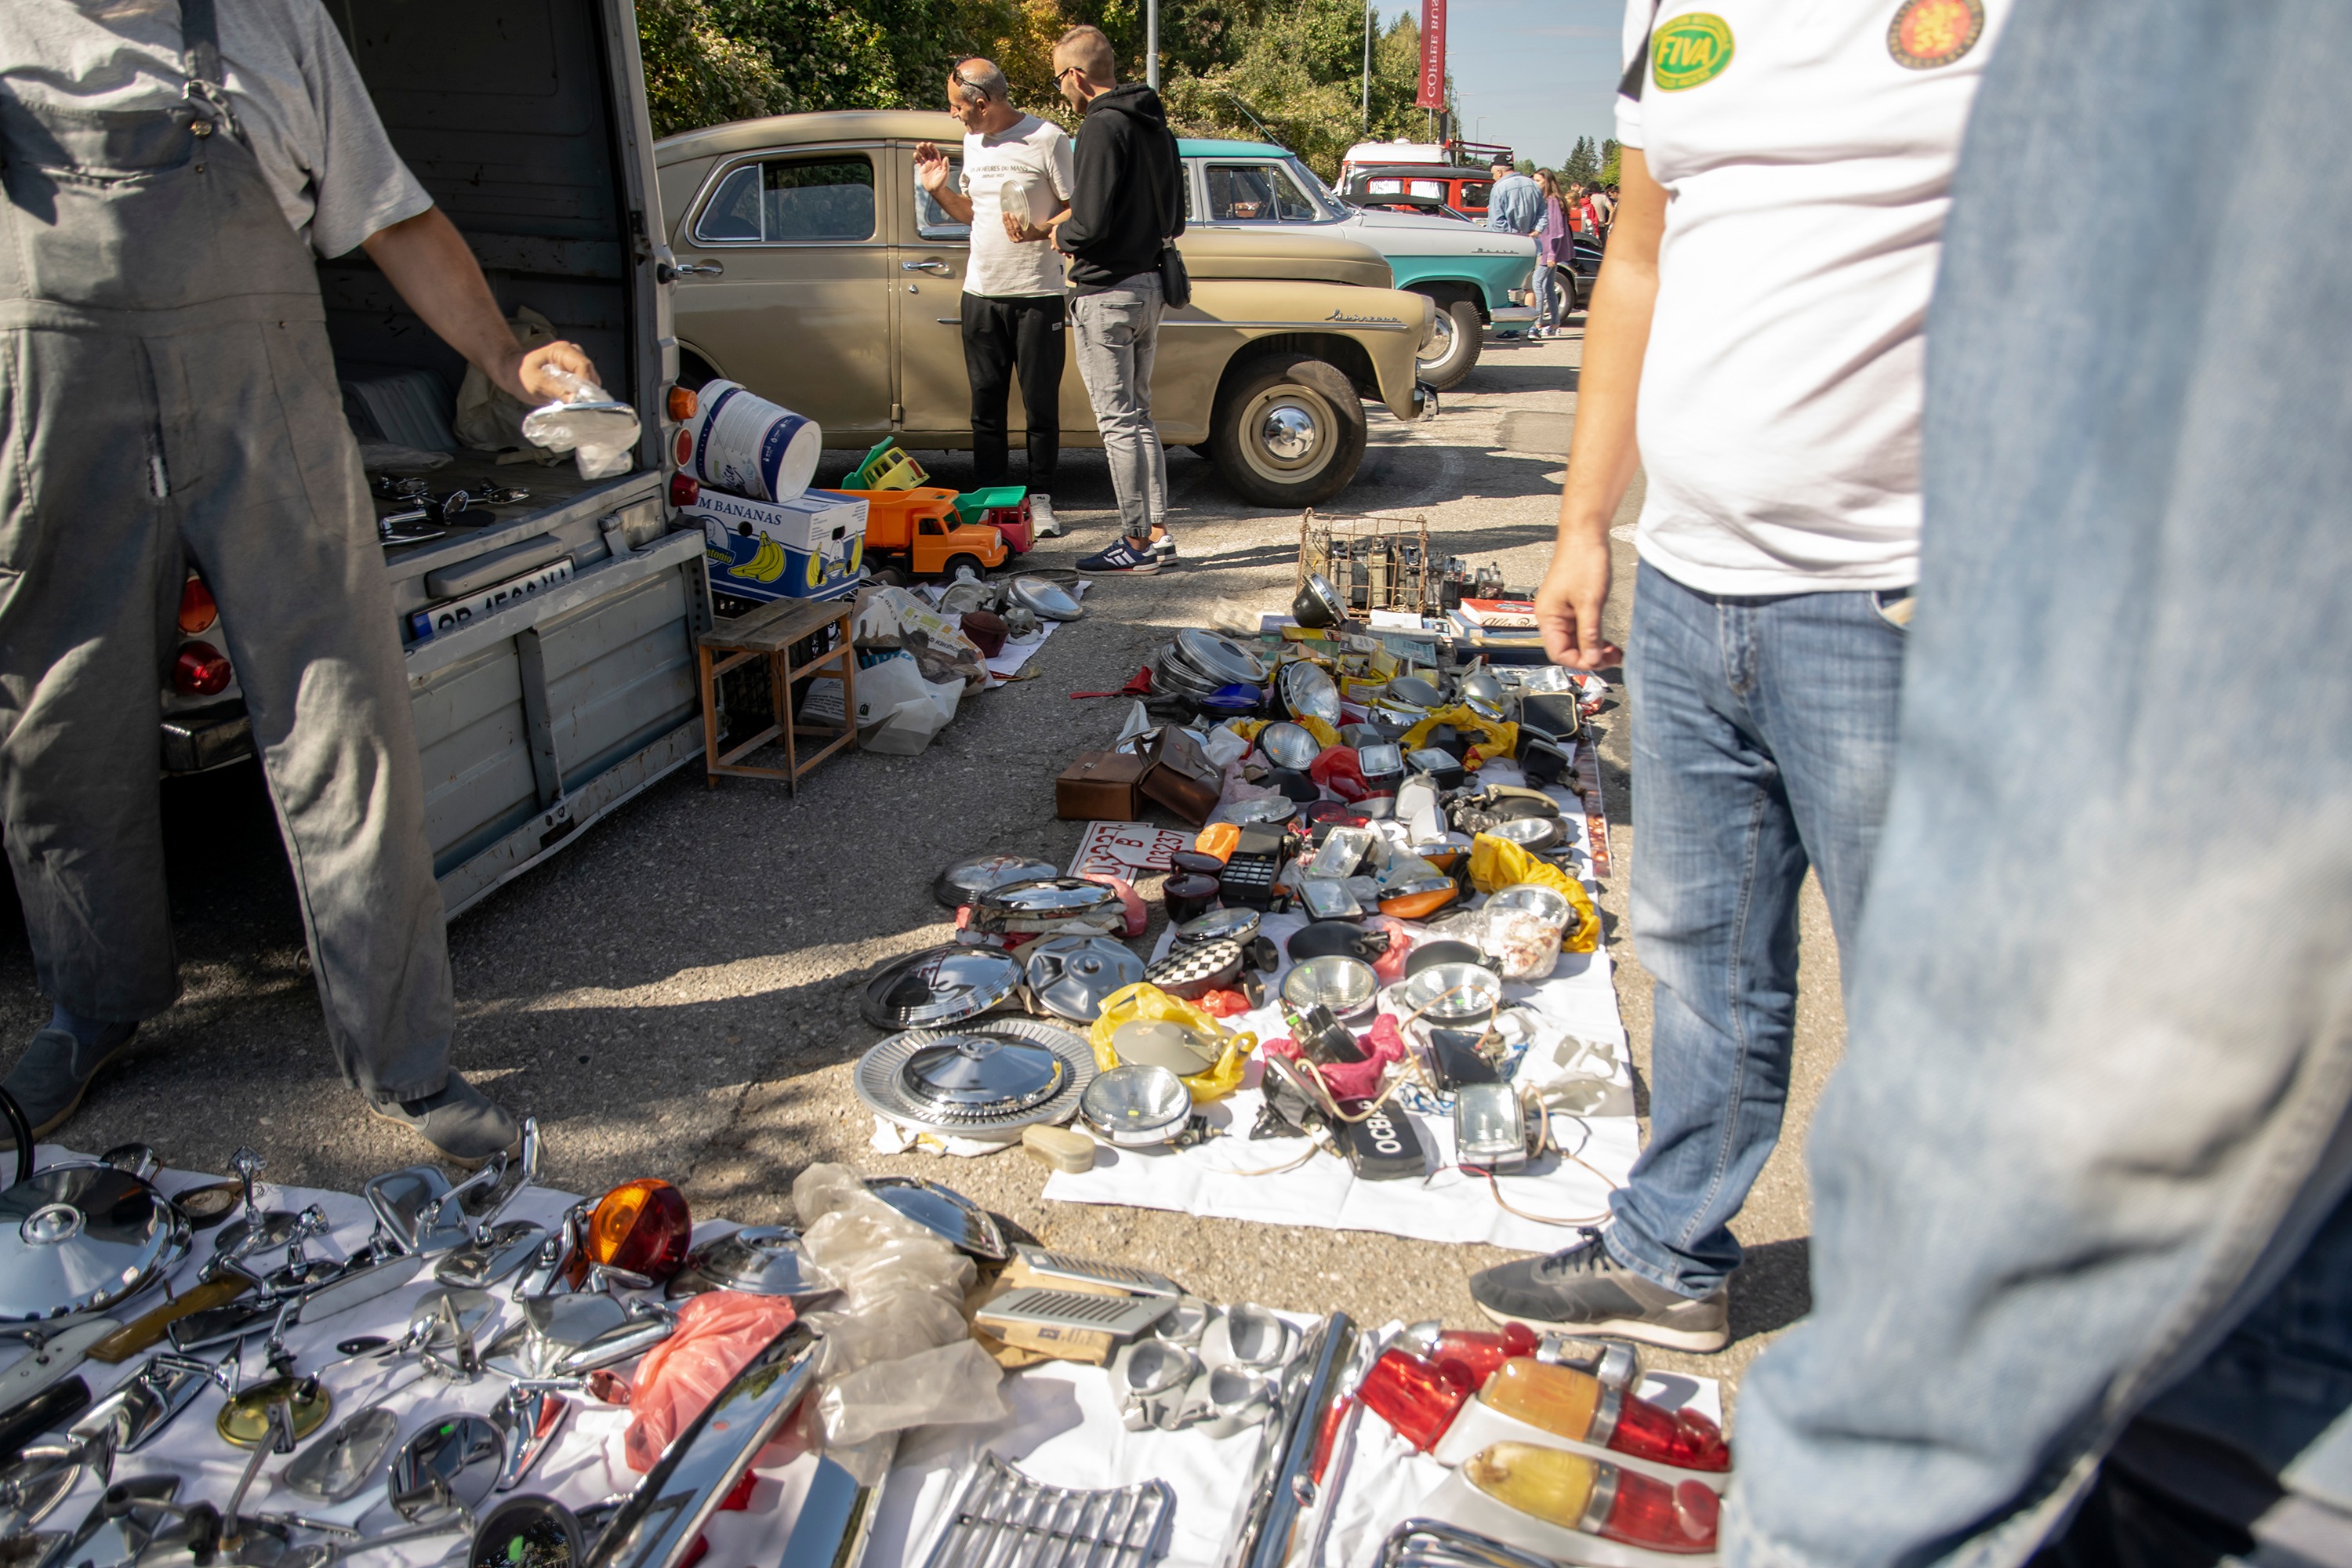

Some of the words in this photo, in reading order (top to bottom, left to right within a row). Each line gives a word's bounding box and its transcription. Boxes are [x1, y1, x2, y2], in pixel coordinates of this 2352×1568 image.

[1657, 36, 1712, 66] FIVA
[698, 496, 712, 509] M
[714, 500, 782, 525] BANANAS
[706, 550, 733, 564] ntonio
[935, 637, 960, 654] ОЦЕНЕН
[1115, 838, 1144, 848] B
[1146, 830, 1185, 864] 03237
